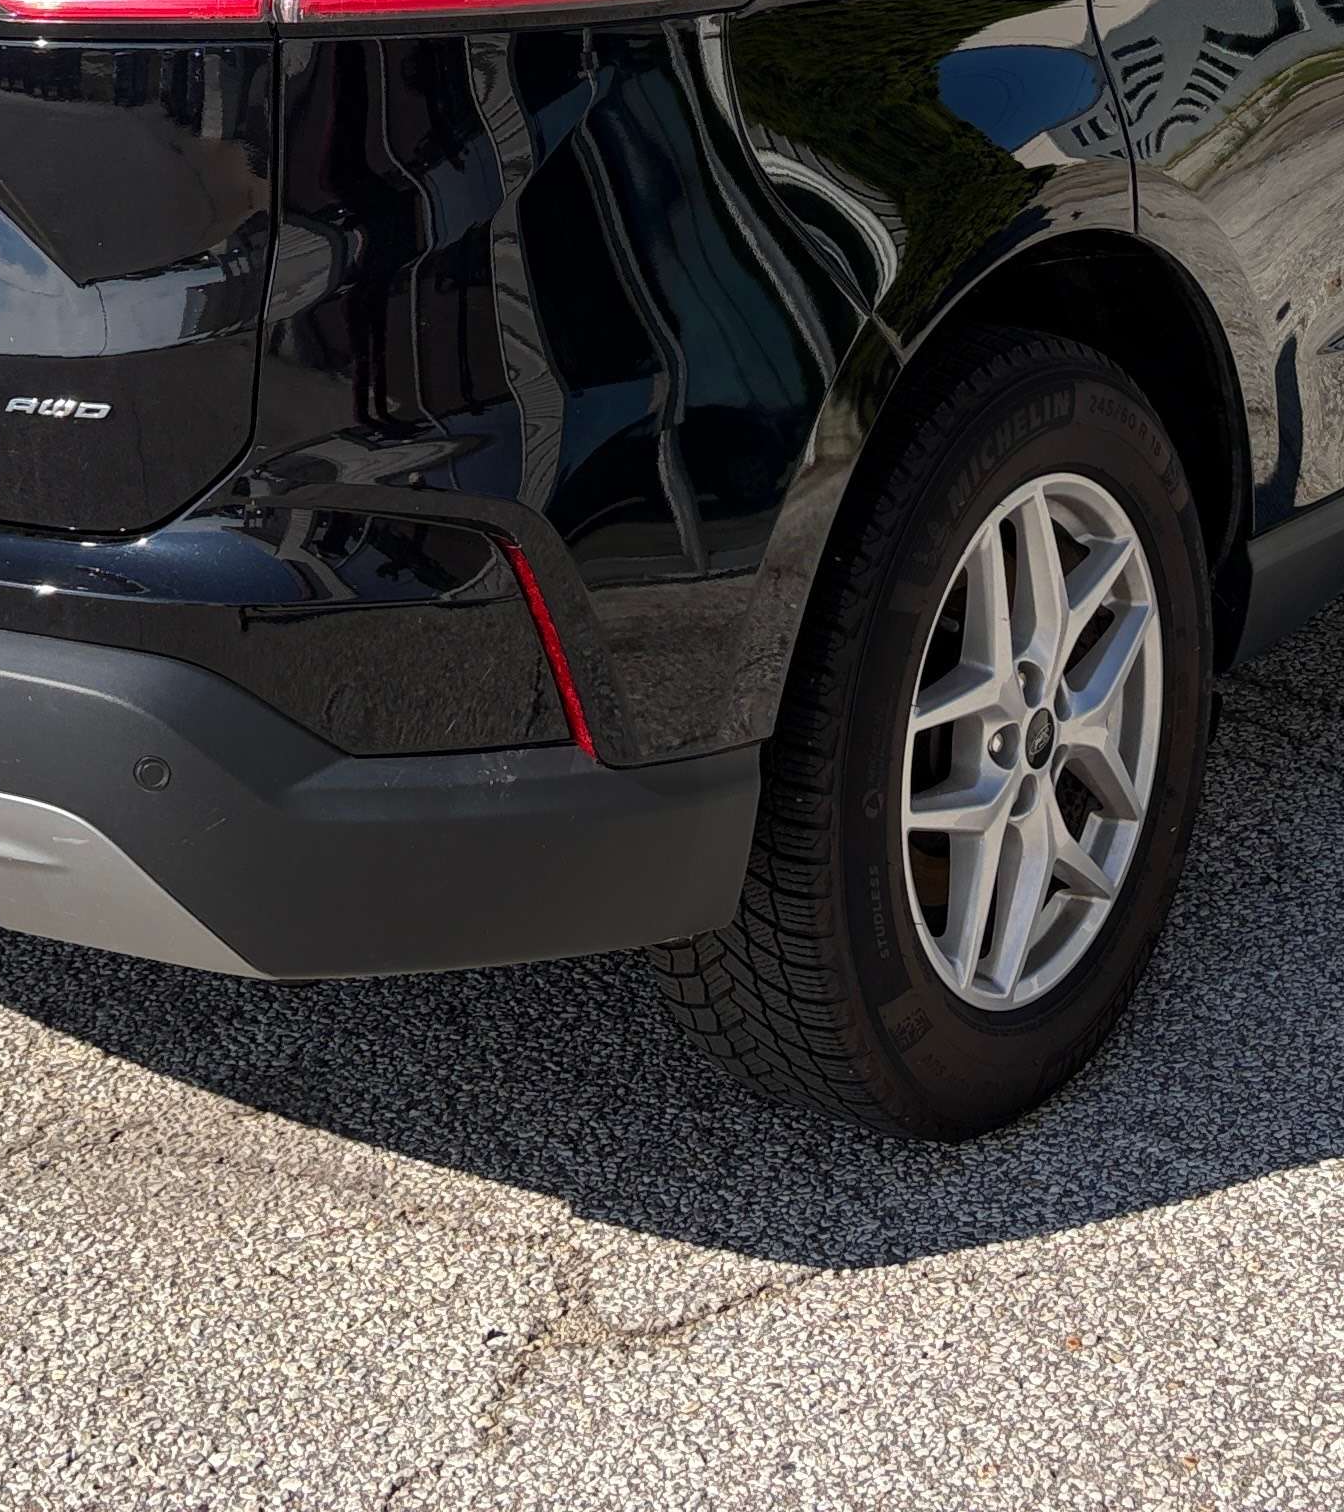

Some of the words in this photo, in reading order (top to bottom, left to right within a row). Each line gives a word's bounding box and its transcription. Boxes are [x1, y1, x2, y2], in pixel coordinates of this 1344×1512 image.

[4, 396, 113, 419] AWD
[946, 390, 1072, 516] MICHELIN
[867, 863, 891, 961] STUDLESS
